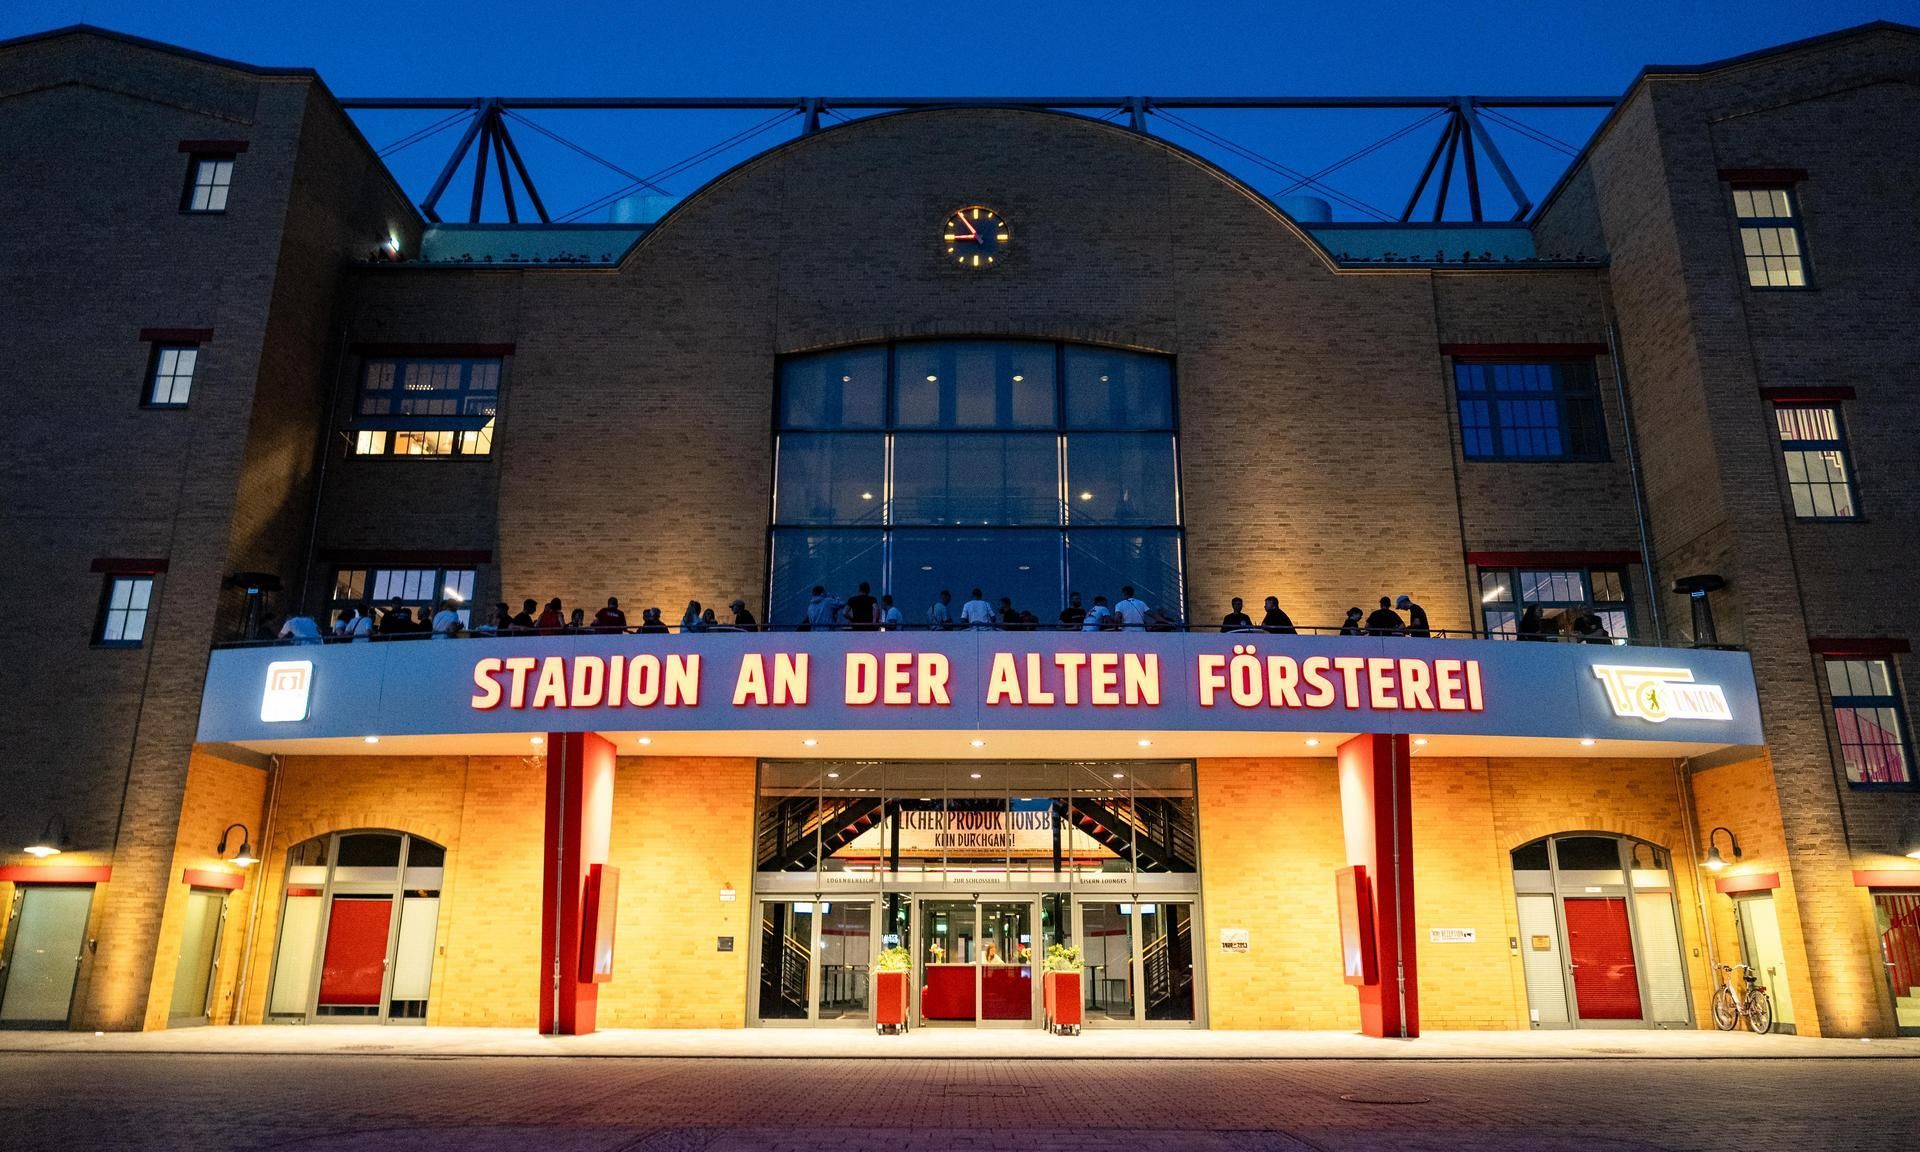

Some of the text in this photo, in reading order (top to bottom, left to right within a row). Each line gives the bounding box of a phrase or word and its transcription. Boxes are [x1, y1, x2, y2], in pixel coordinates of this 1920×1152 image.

[471, 644, 1486, 711] STADION AN DER ALTEN FÖRSTEREI
